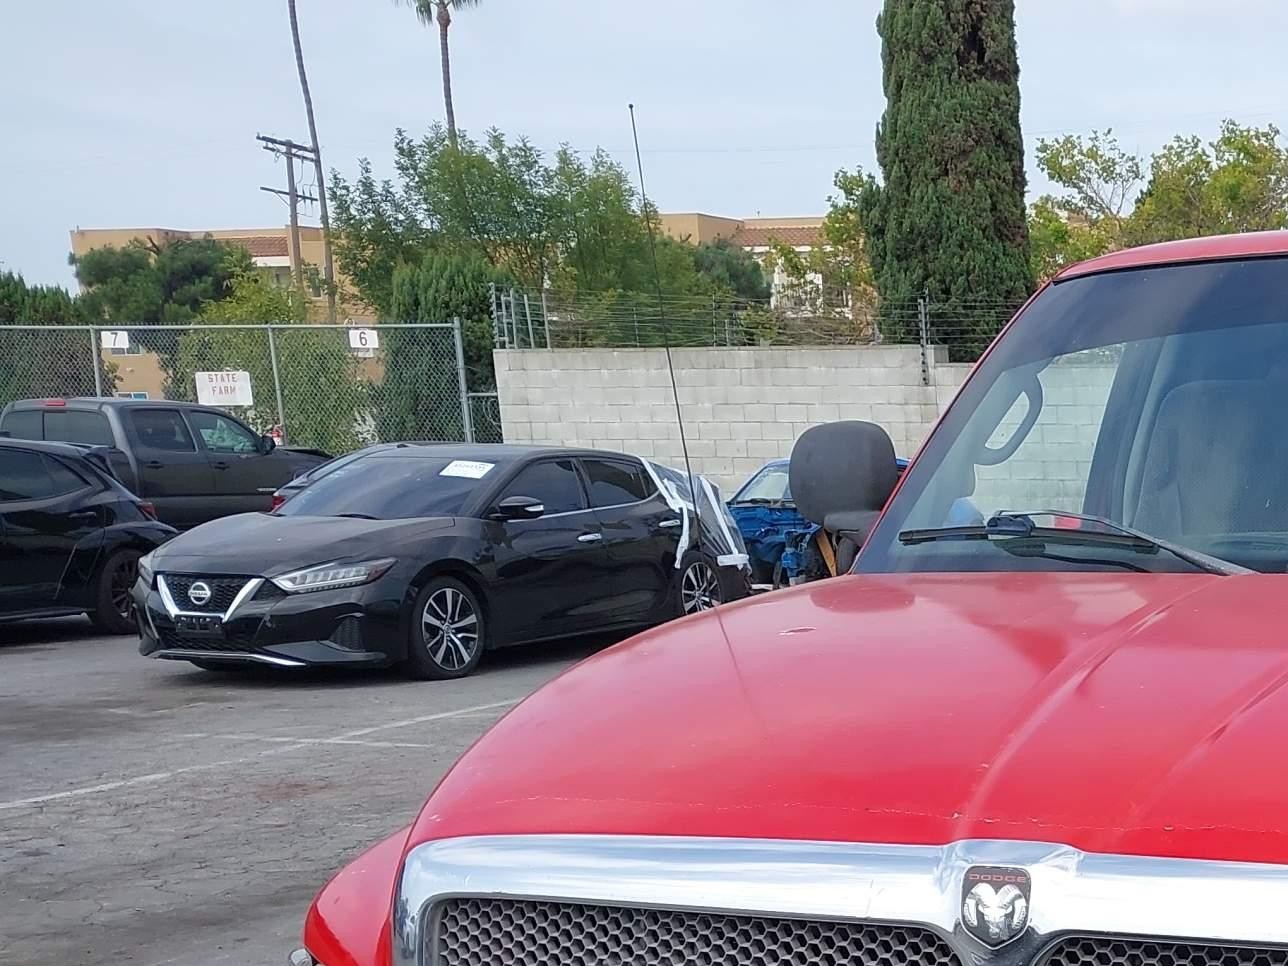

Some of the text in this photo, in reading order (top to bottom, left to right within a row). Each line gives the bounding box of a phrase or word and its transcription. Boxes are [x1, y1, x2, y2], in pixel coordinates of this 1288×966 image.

[110, 332, 118, 347] 7
[359, 331, 368, 346] 6
[207, 373, 238, 383] STATE
[211, 385, 237, 396] FARM
[968, 873, 1027, 883] DODGE
